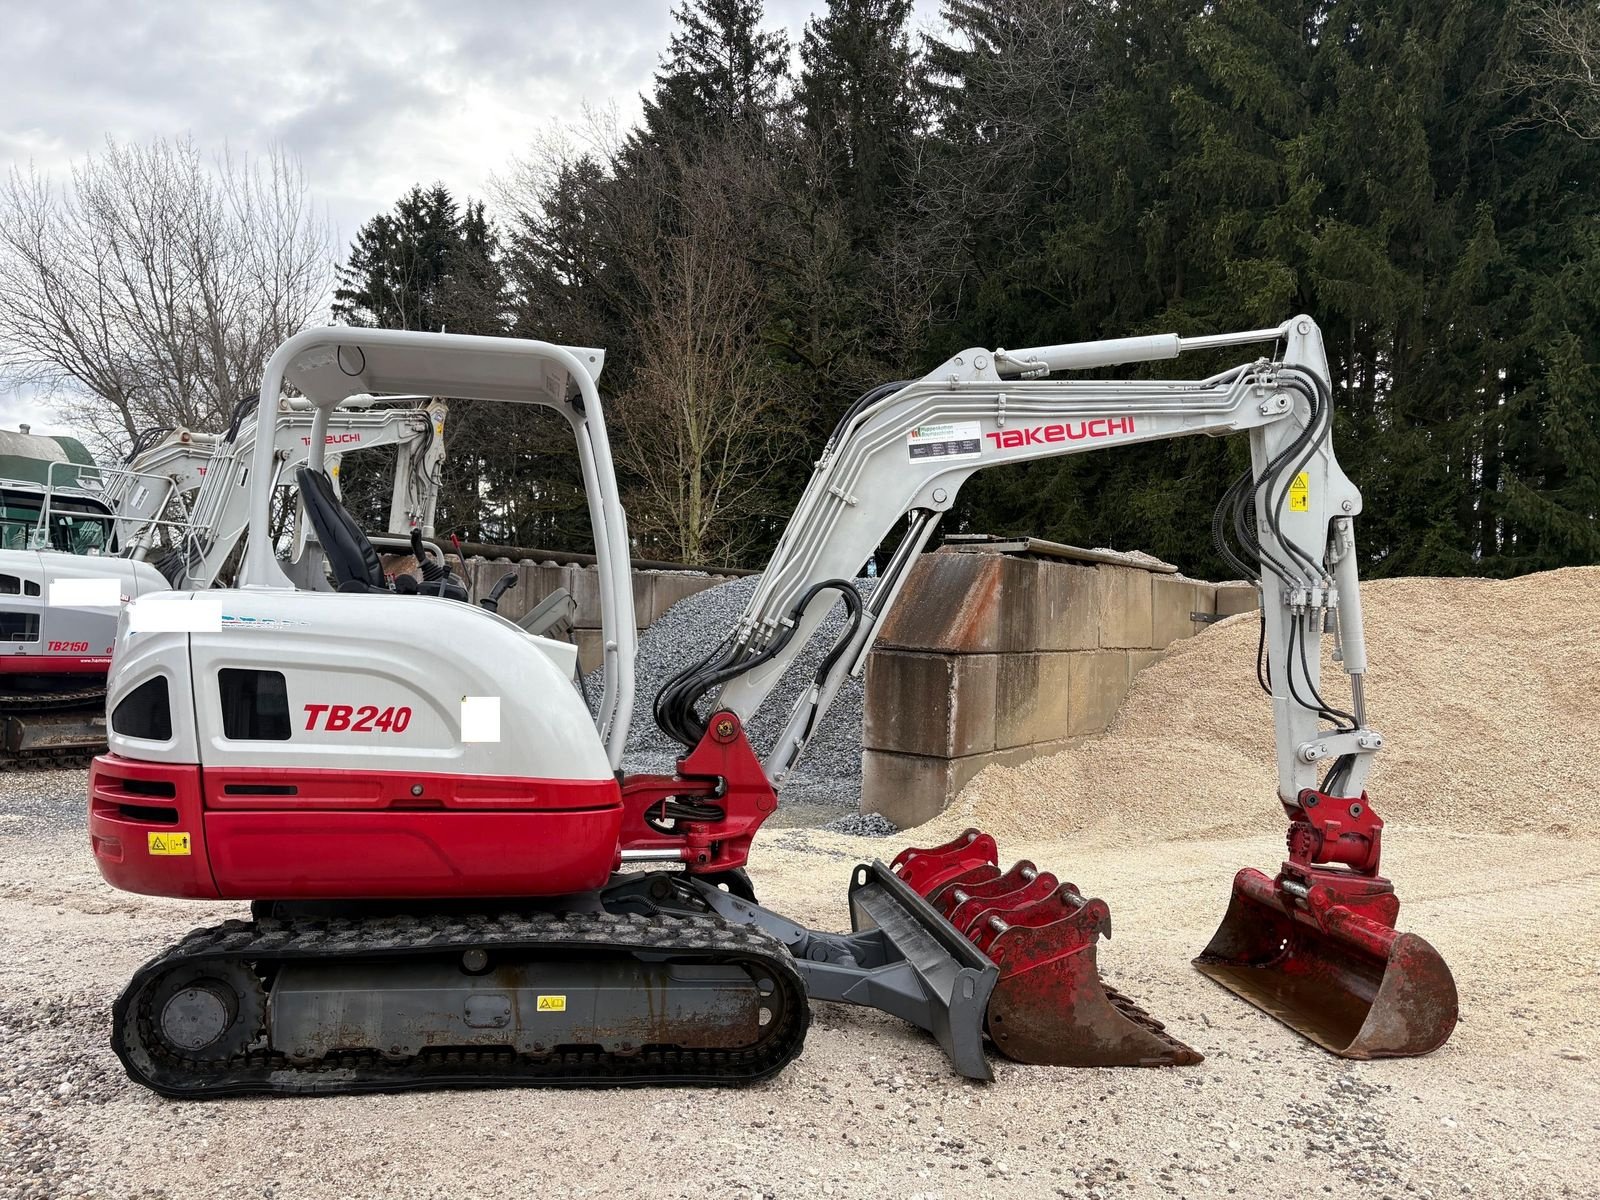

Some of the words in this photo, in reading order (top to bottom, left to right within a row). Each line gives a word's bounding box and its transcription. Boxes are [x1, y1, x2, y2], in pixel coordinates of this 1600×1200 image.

[301, 433, 361, 446] TEUCHI
[986, 416, 1135, 449] TAKEUCHI
[48, 641, 89, 652] TB2150
[303, 704, 412, 733] TB240
